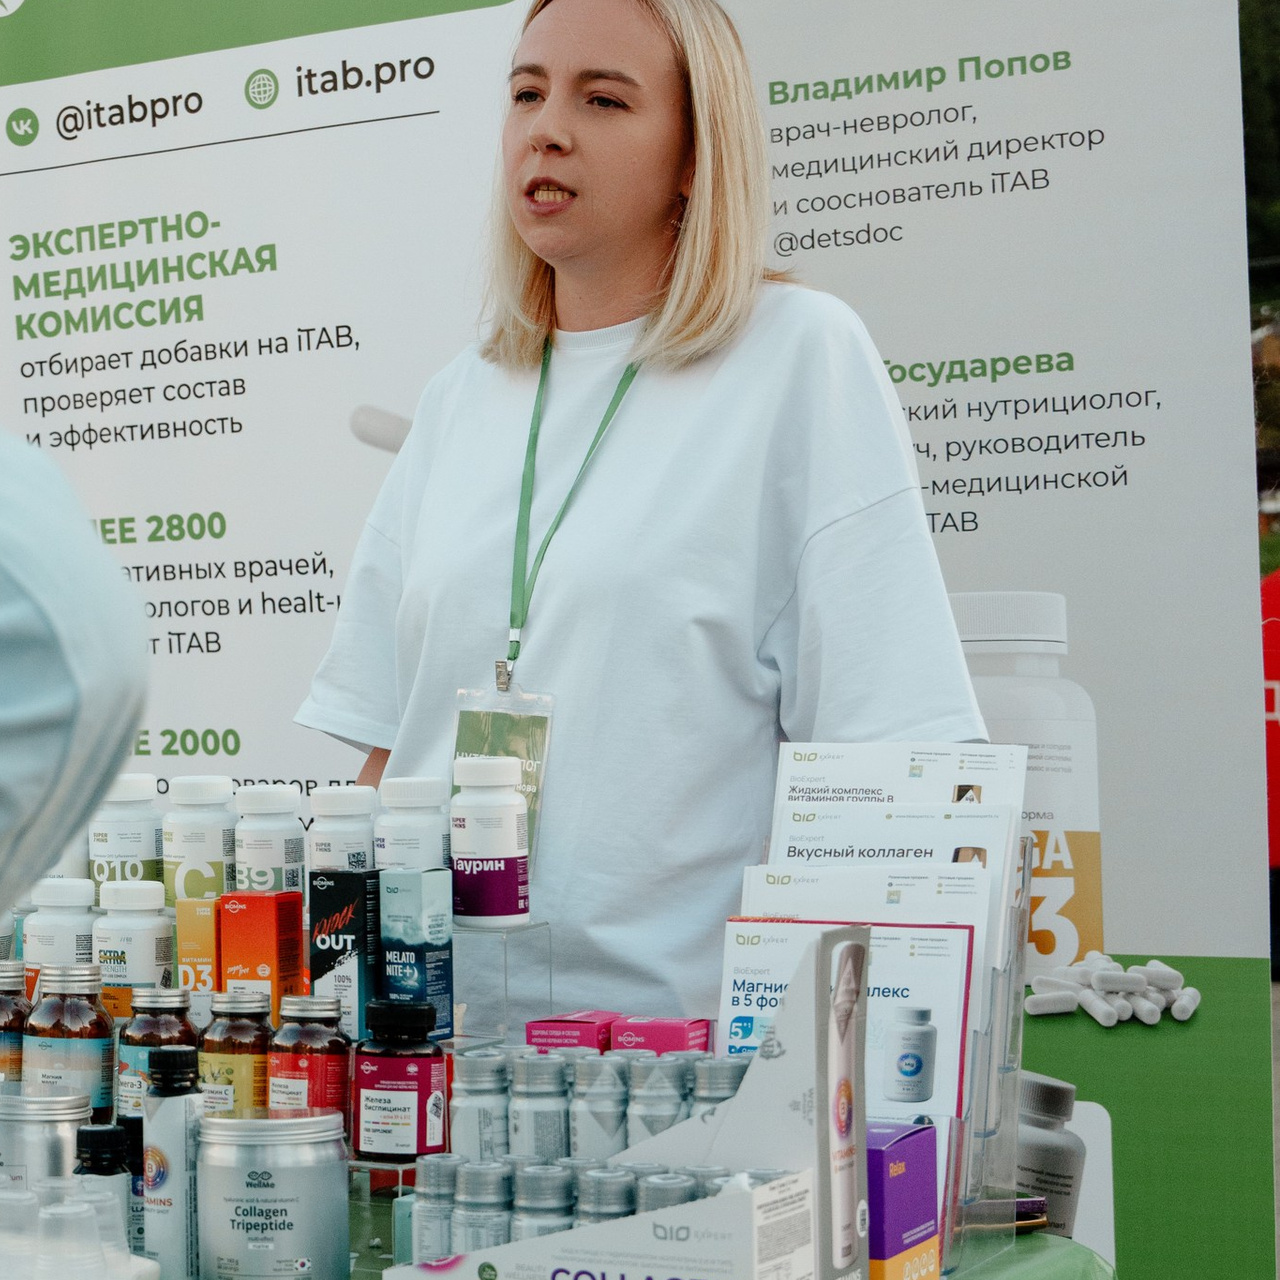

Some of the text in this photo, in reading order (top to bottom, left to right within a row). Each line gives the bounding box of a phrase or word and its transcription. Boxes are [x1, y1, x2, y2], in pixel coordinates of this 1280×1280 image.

[295, 53, 436, 99] itab.pro
[768, 49, 1073, 106] Владимир Попов
[55, 85, 204, 142] @itabpro
[770, 102, 978, 145] врач-невролог,
[771, 127, 1106, 182] медицинский директор
[772, 167, 1051, 217] и сооснователь iTAB
[9, 210, 221, 262] ЭКСПЕРТНО-
[773, 223, 904, 257] @detsdoc
[12, 244, 278, 301] МЕДИЦИНСКАЯ
[15, 294, 205, 340] КОМИССИЯ
[20, 324, 361, 379] отбирает добавки на iTAB,
[23, 376, 247, 415] проверяет состав
[902, 386, 1163, 423] кий нутрициолог,
[26, 414, 243, 452] и эффективность
[913, 427, 1146, 463] ч, руководитель
[921, 465, 1129, 498] -медицинской
[92, 511, 227, 545] ЕЕ 2800
[926, 511, 979, 535] TAB
[233, 552, 334, 583] врачей,
[238, 598, 252, 615] и
[168, 631, 222, 655] iTAB
[160, 728, 241, 756] 2000
[516, 783, 537, 794] нова
[788, 785, 883, 795] Жидкий комплекс
[790, 776, 826, 784] BioExpert
[1021, 811, 1054, 822] орма
[789, 835, 825, 843] BioExpert
[786, 844, 934, 860] Вкусный коллаген
[93, 859, 144, 881] Q10
[453, 858, 505, 875] Таурин
[235, 867, 275, 890] B9
[316, 934, 356, 951] OUT
[386, 950, 416, 963] MELATO
[178, 964, 213, 992] D3
[334, 975, 352, 984] 100%
[733, 966, 771, 976] BioExpert
[732, 993, 780, 1011] в 5 фо
[618, 1035, 645, 1043] BIOMINS
[119, 1081, 142, 1089] мега-3
[202, 1087, 223, 1095] итамин
[245, 1179, 275, 1189] WellMe
[144, 1198, 173, 1207] AMINS
[234, 1205, 288, 1220] Collagen
[230, 1219, 294, 1233] Tripeptide
